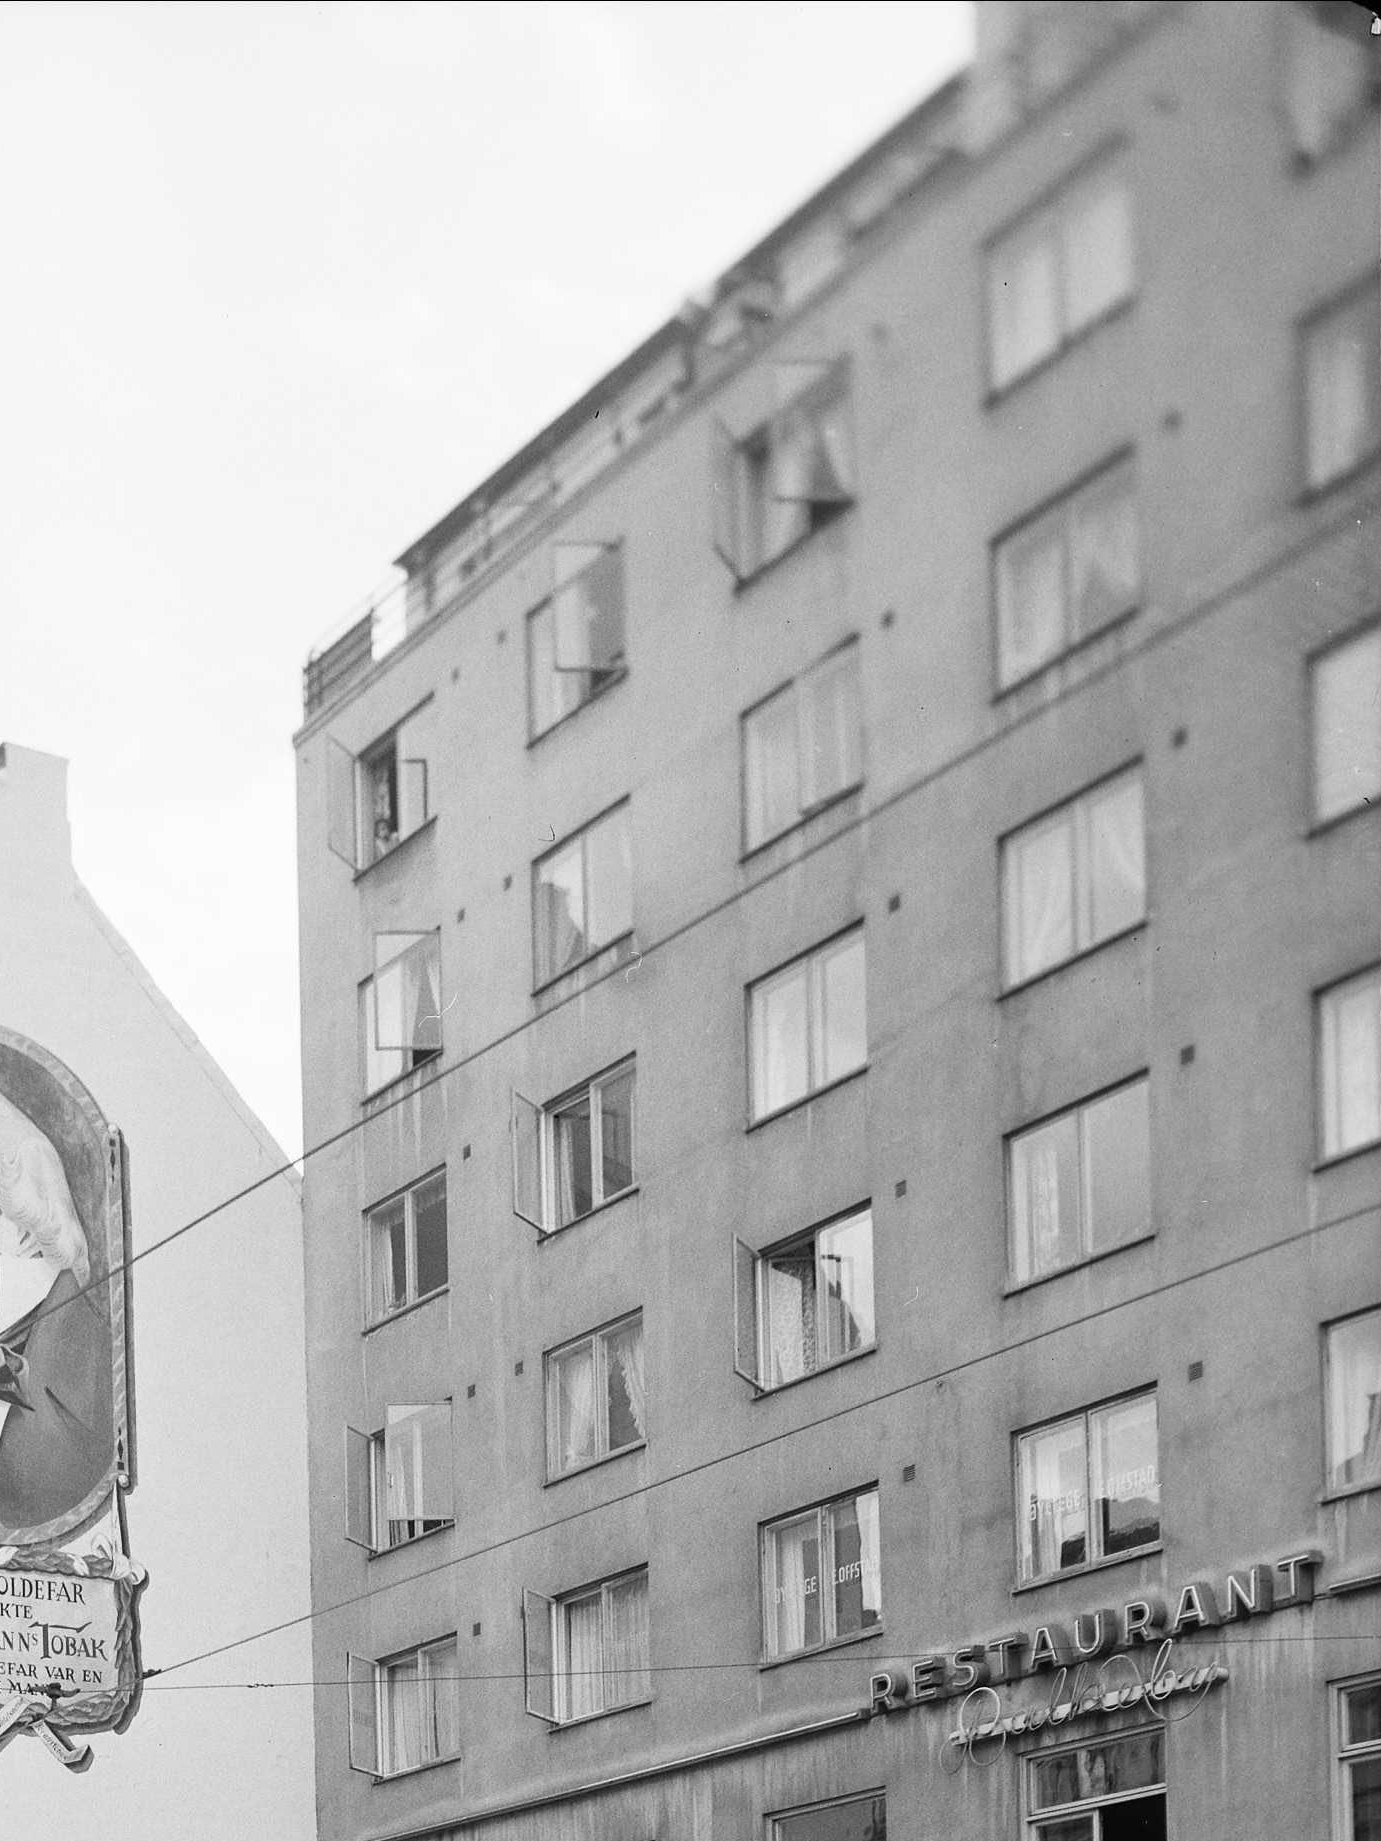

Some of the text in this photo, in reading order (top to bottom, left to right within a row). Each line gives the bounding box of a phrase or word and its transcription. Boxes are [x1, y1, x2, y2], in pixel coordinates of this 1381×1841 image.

[28, 1621, 109, 1661] TOBAK
[868, 1548, 1322, 1716] RESTAURANT
[44, 1665, 76, 1683] VAR
[83, 1669, 103, 1683] EN
